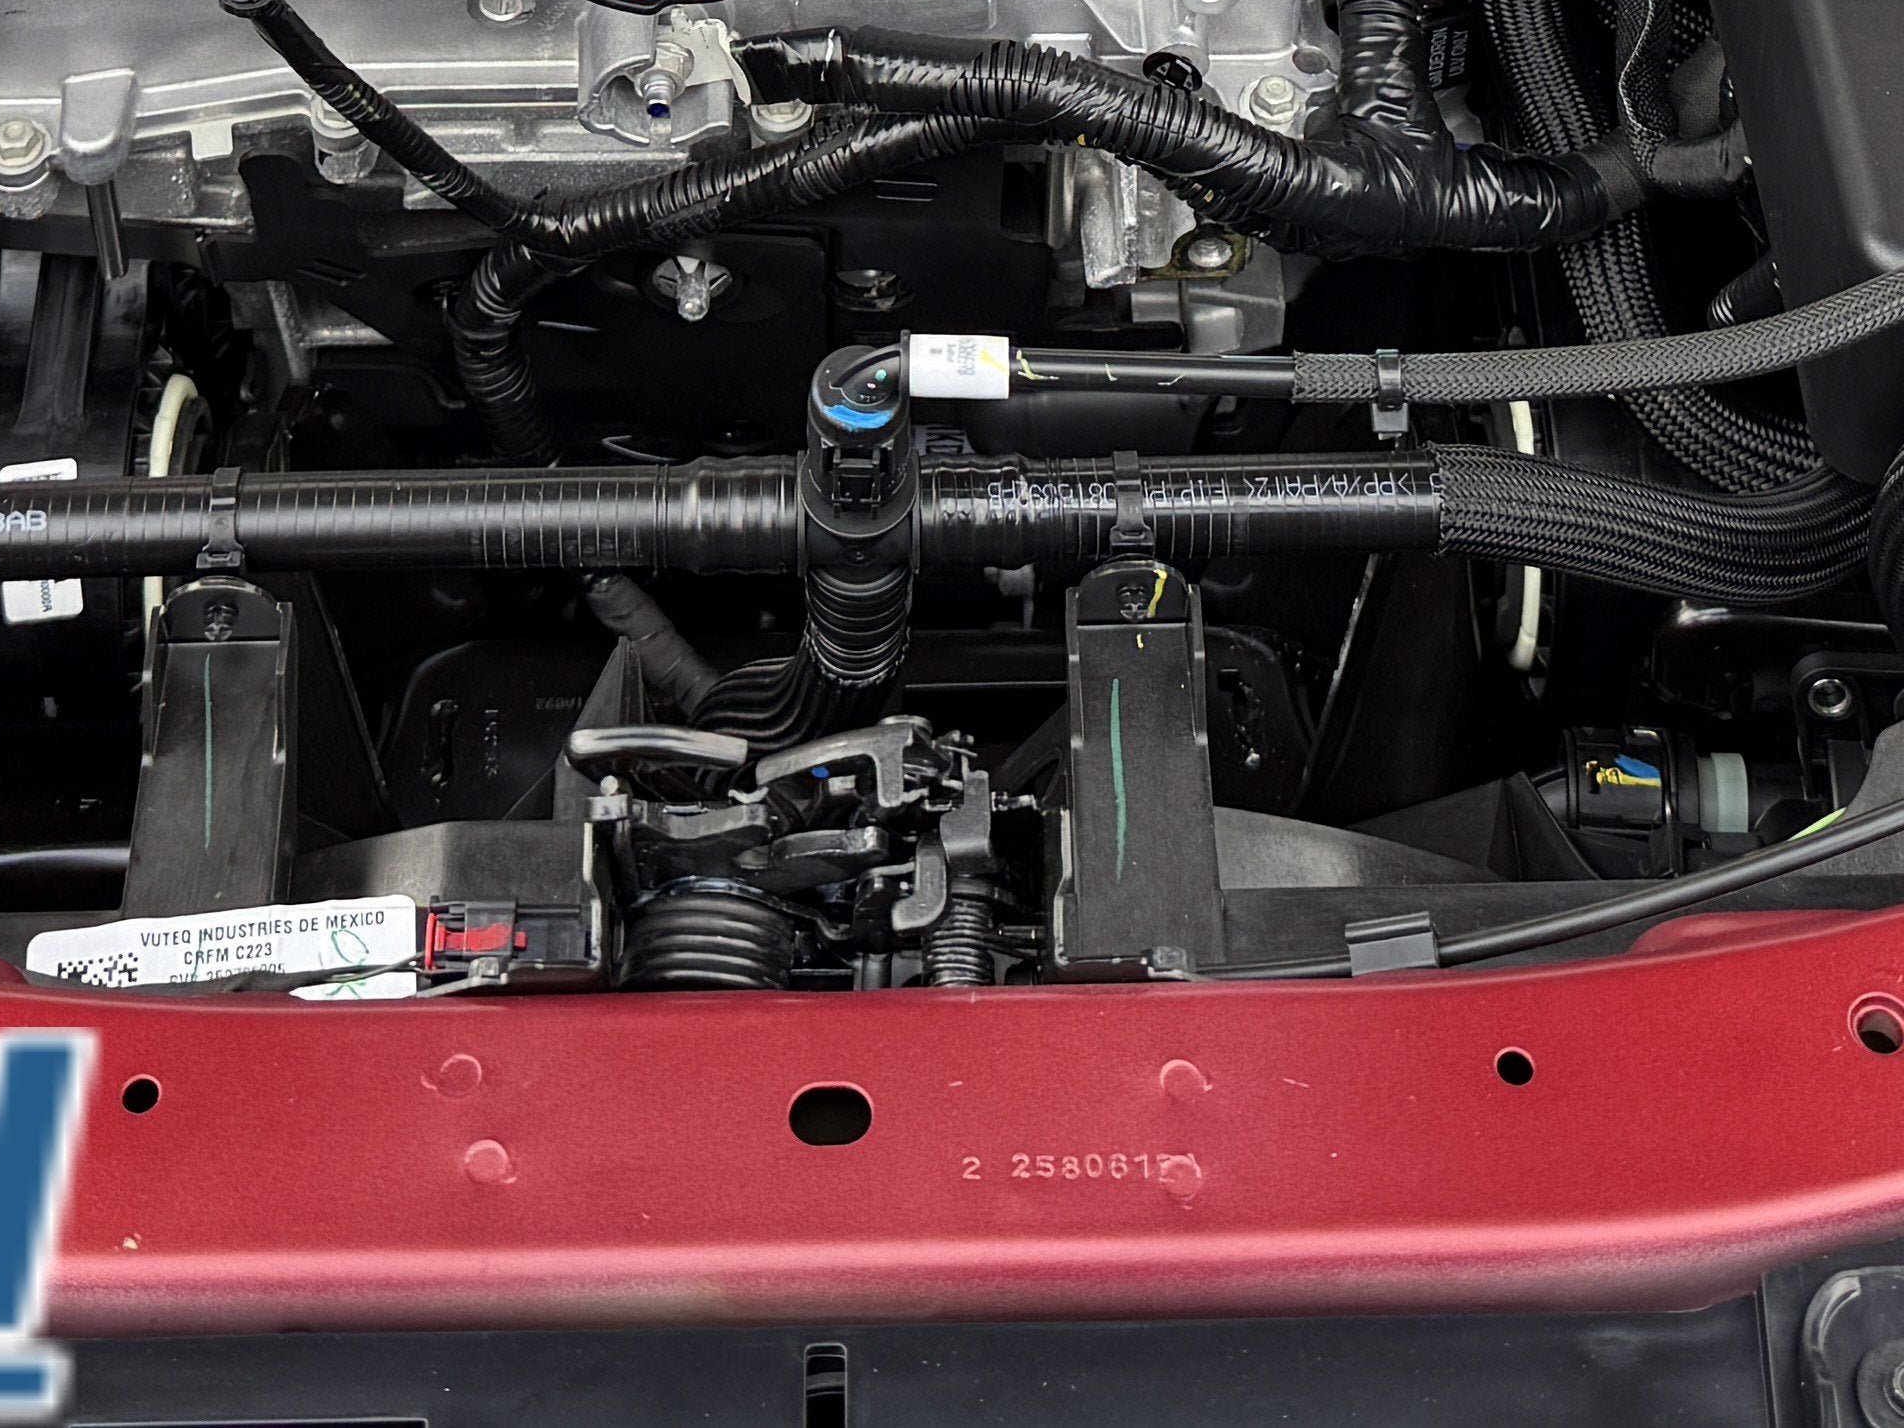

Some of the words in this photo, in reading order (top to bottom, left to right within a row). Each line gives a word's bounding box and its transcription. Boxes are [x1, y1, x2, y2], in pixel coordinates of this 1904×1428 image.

[140, 929, 191, 948] VUTEQ
[198, 920, 293, 944] INDUSTRIES
[298, 916, 320, 933] DE
[325, 910, 386, 930] MEXICO
[183, 948, 230, 966] CRFM
[235, 941, 273, 961] C223
